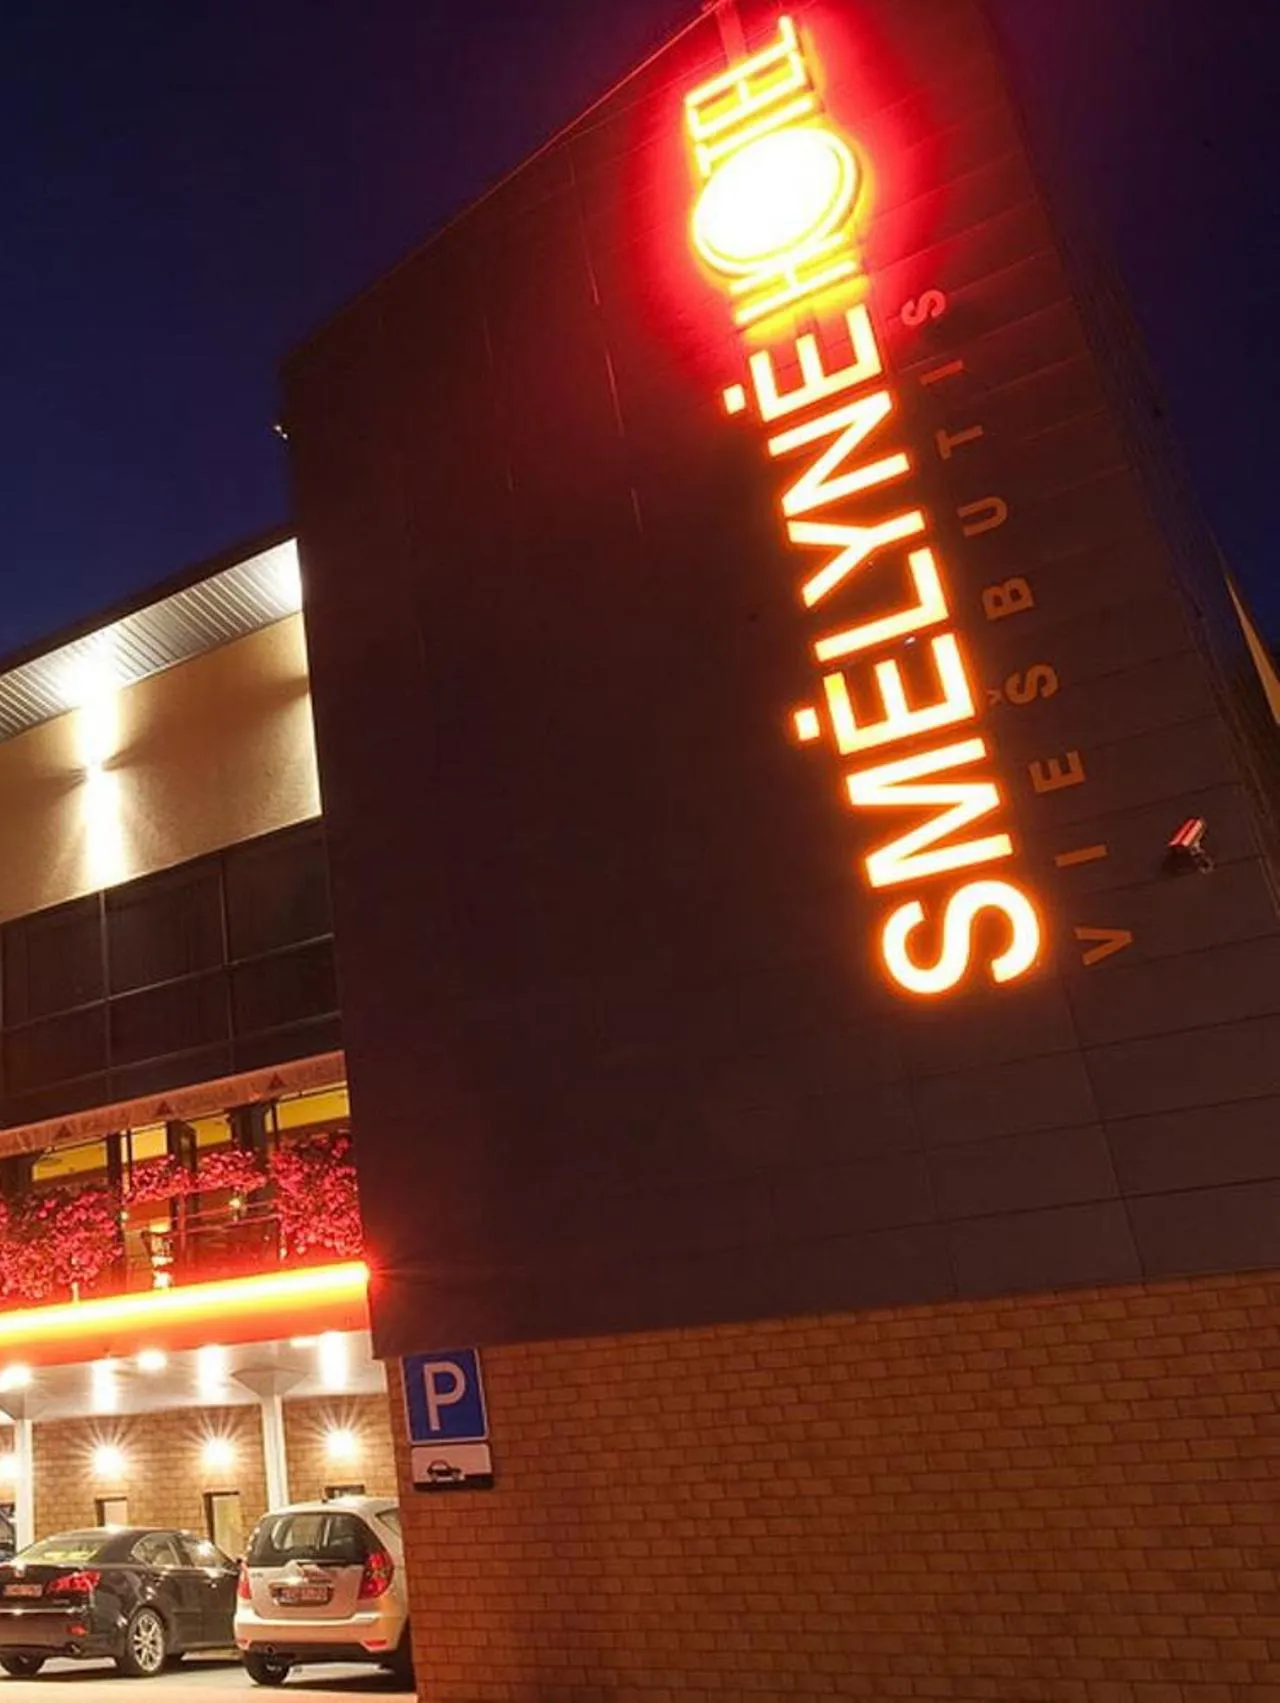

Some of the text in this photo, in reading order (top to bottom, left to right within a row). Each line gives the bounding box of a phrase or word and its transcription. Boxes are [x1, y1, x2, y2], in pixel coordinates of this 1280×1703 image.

[683, 15, 1041, 994] SMĖLYNĖ HOTEL
[900, 288, 1133, 967] VIEŠBUTIS
[423, 1361, 465, 1431] P
